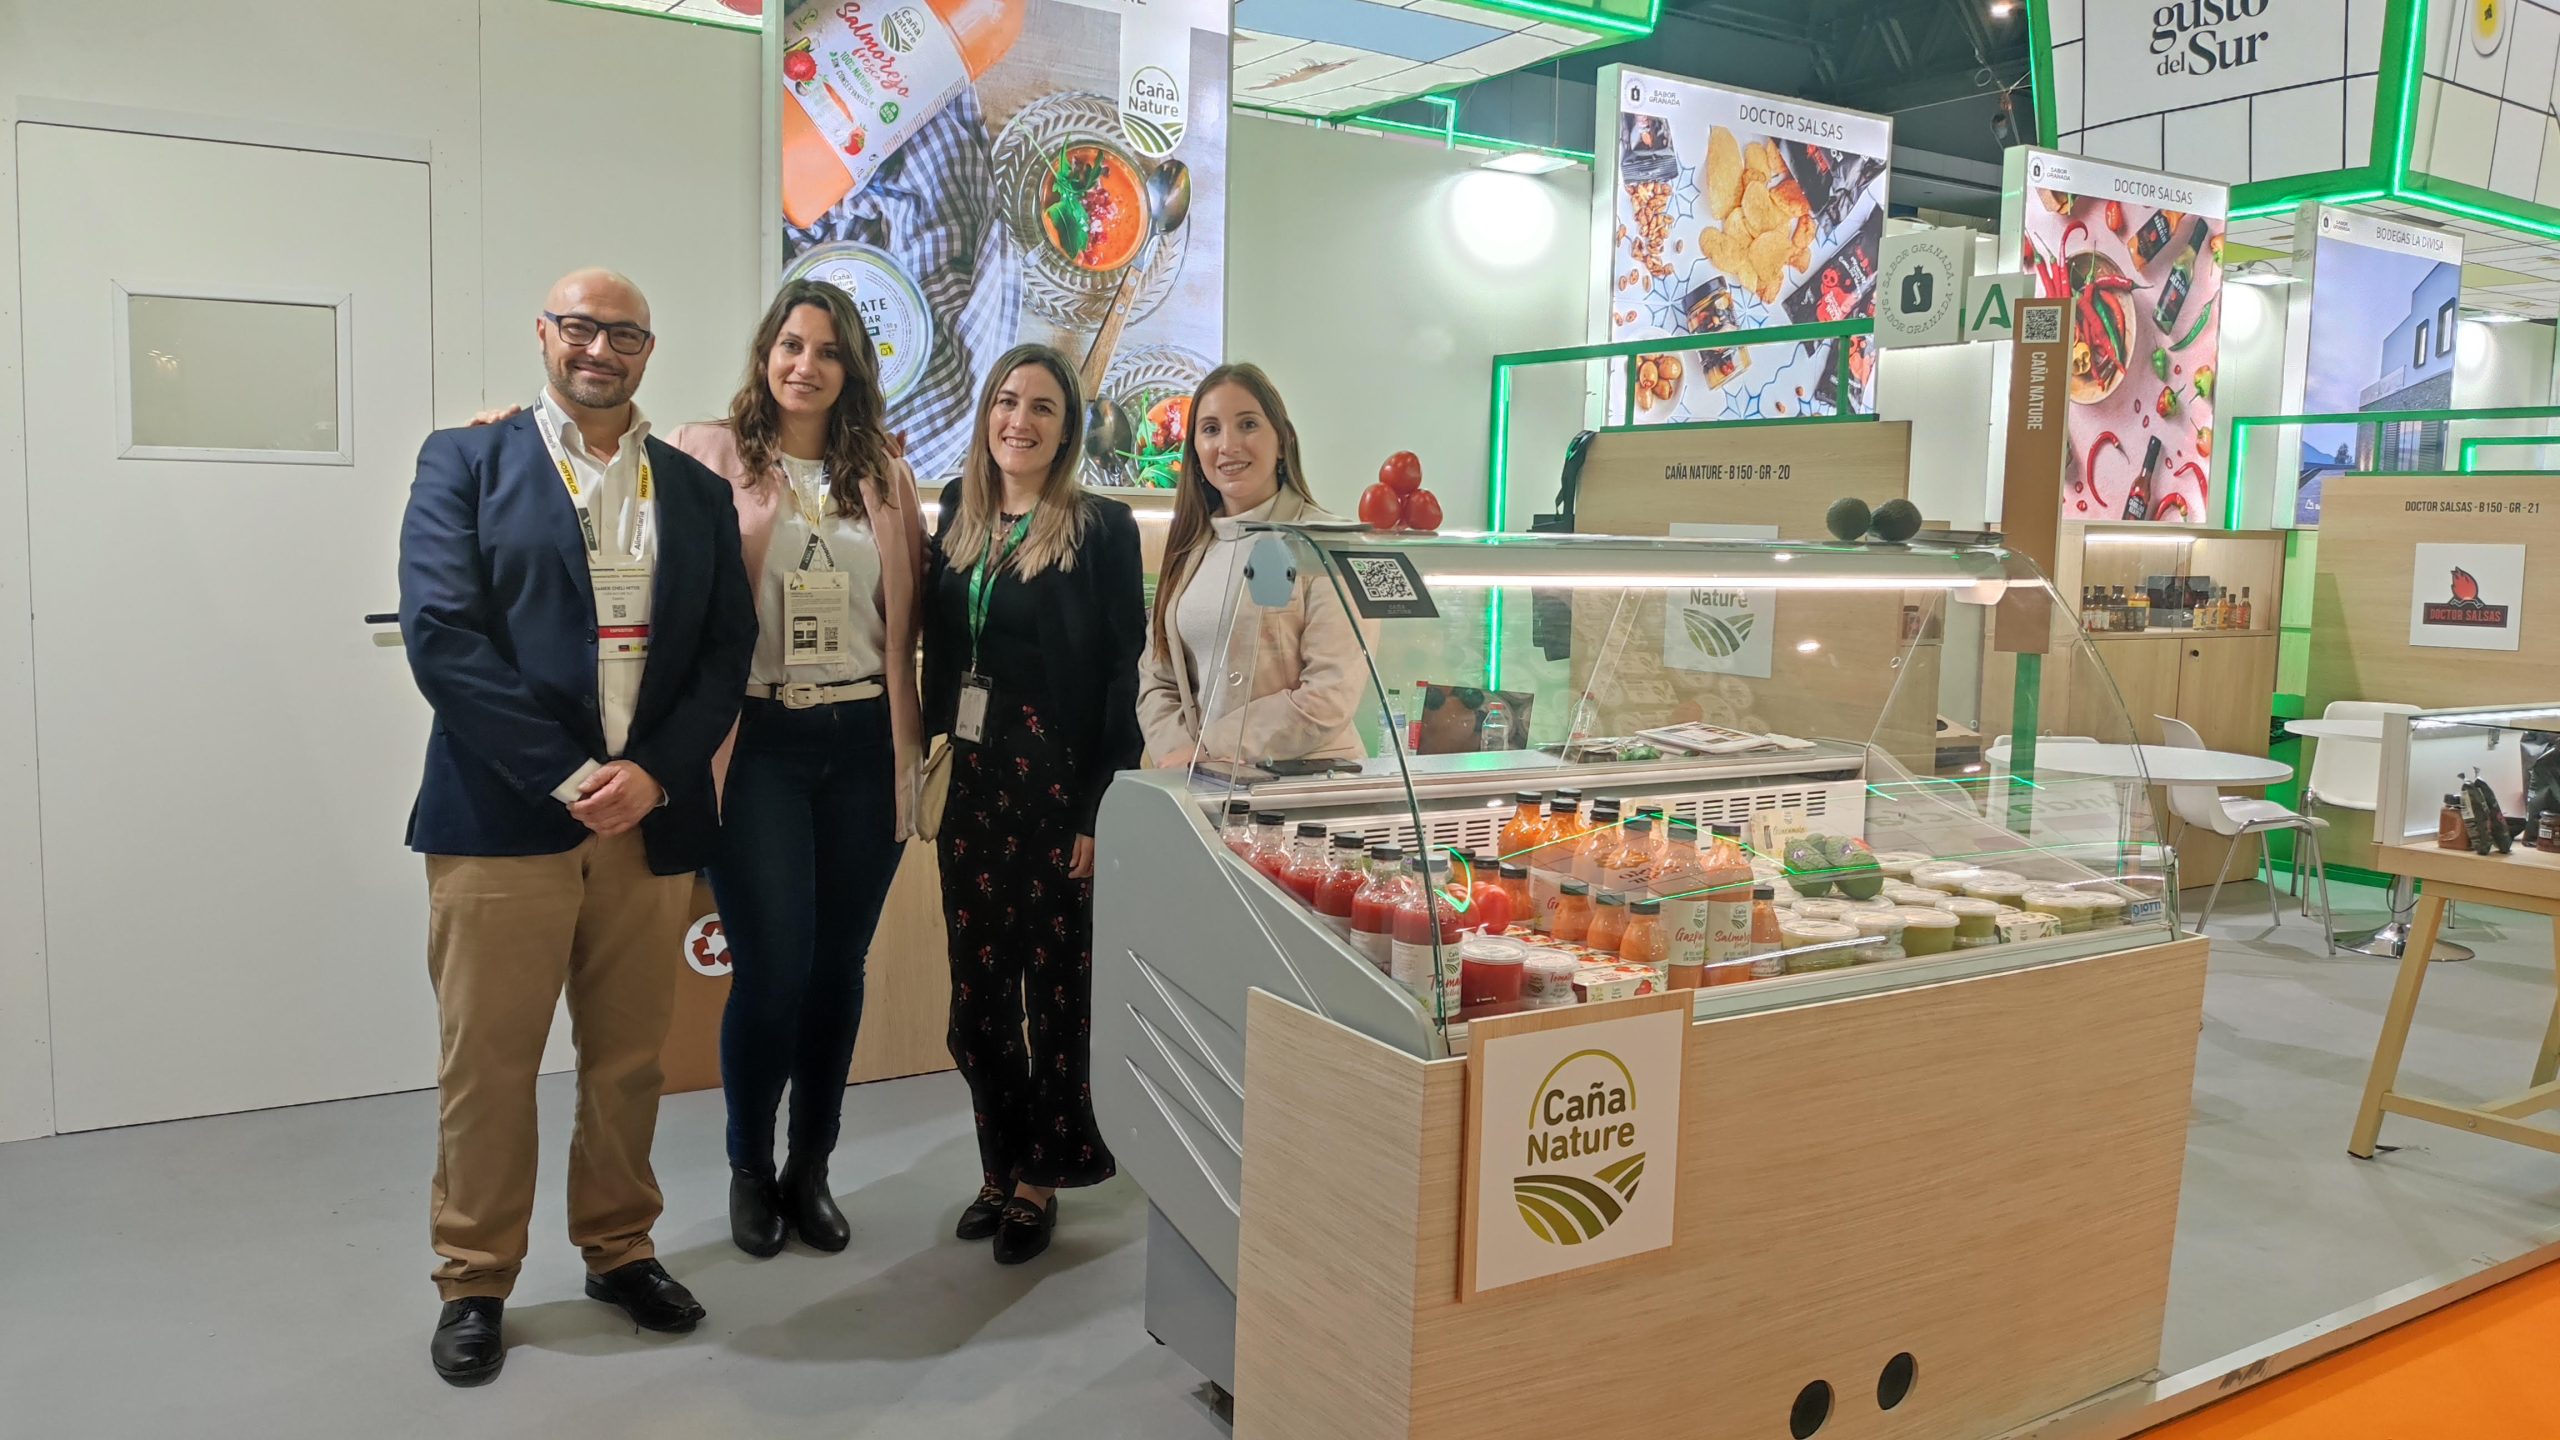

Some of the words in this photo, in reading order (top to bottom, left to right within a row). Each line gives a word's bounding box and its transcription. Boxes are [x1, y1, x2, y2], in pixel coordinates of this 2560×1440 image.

[836, 2, 909, 98] Salmorejo
[2157, 51, 2185, 76] del
[2188, 30, 2269, 75] Sur
[1136, 79, 1175, 101] Caña
[1128, 96, 1179, 118] Nature
[1739, 104, 1794, 130] DOCTOR
[1798, 116, 1844, 141] SALSAS
[2114, 178, 2156, 199] DOCTOR
[2158, 187, 2193, 205] SALSAS
[2376, 226, 2411, 245] BODEGAS
[2411, 233, 2421, 246] LA
[2029, 352, 2047, 383] CAÑA
[2026, 385, 2046, 431] NATURE
[559, 459, 579, 496] HOSTELCO
[640, 464, 648, 498] HOSTELCO
[1665, 463, 1688, 480] CAÑA
[1689, 464, 1723, 480] NATURE
[2405, 500, 2438, 512] DOCTOR
[2440, 501, 2473, 513] SALSAS
[633, 510, 645, 551] Alimentaria
[1689, 587, 1749, 609] Nature
[2429, 608, 2463, 621] DOCTOR
[2465, 610, 2502, 622] SALSAS
[1543, 1081, 1626, 1127] Caña
[1526, 1121, 1635, 1167] Nature
